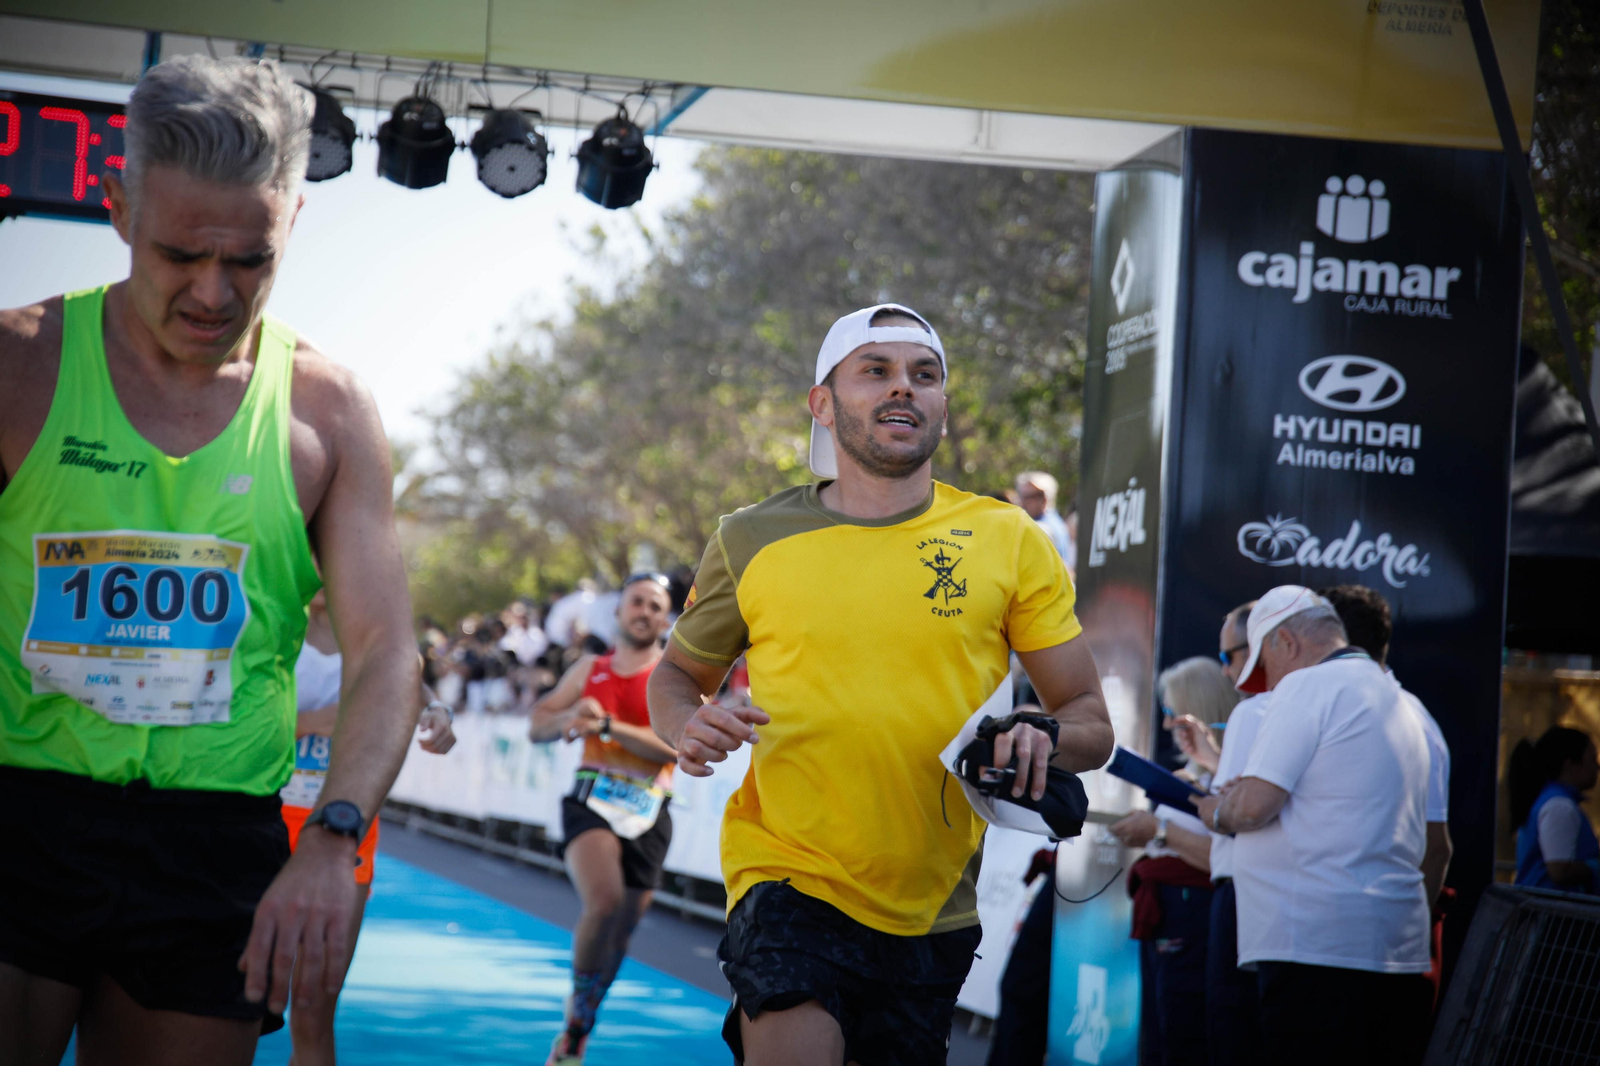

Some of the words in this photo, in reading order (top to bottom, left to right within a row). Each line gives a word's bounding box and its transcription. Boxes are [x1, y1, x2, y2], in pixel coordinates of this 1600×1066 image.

[1238, 241, 1461, 303] cajamar
[1344, 295, 1390, 315] CAJA
[1394, 299, 1452, 319] RURAL
[1273, 413, 1421, 449] HYUNDAI
[1276, 442, 1415, 475] Almerialva
[149, 549, 180, 560] 2024
[916, 541, 927, 550] LA
[62, 564, 229, 623] 1600
[931, 606, 963, 617] CEUTA
[105, 624, 171, 640] JAVIER
